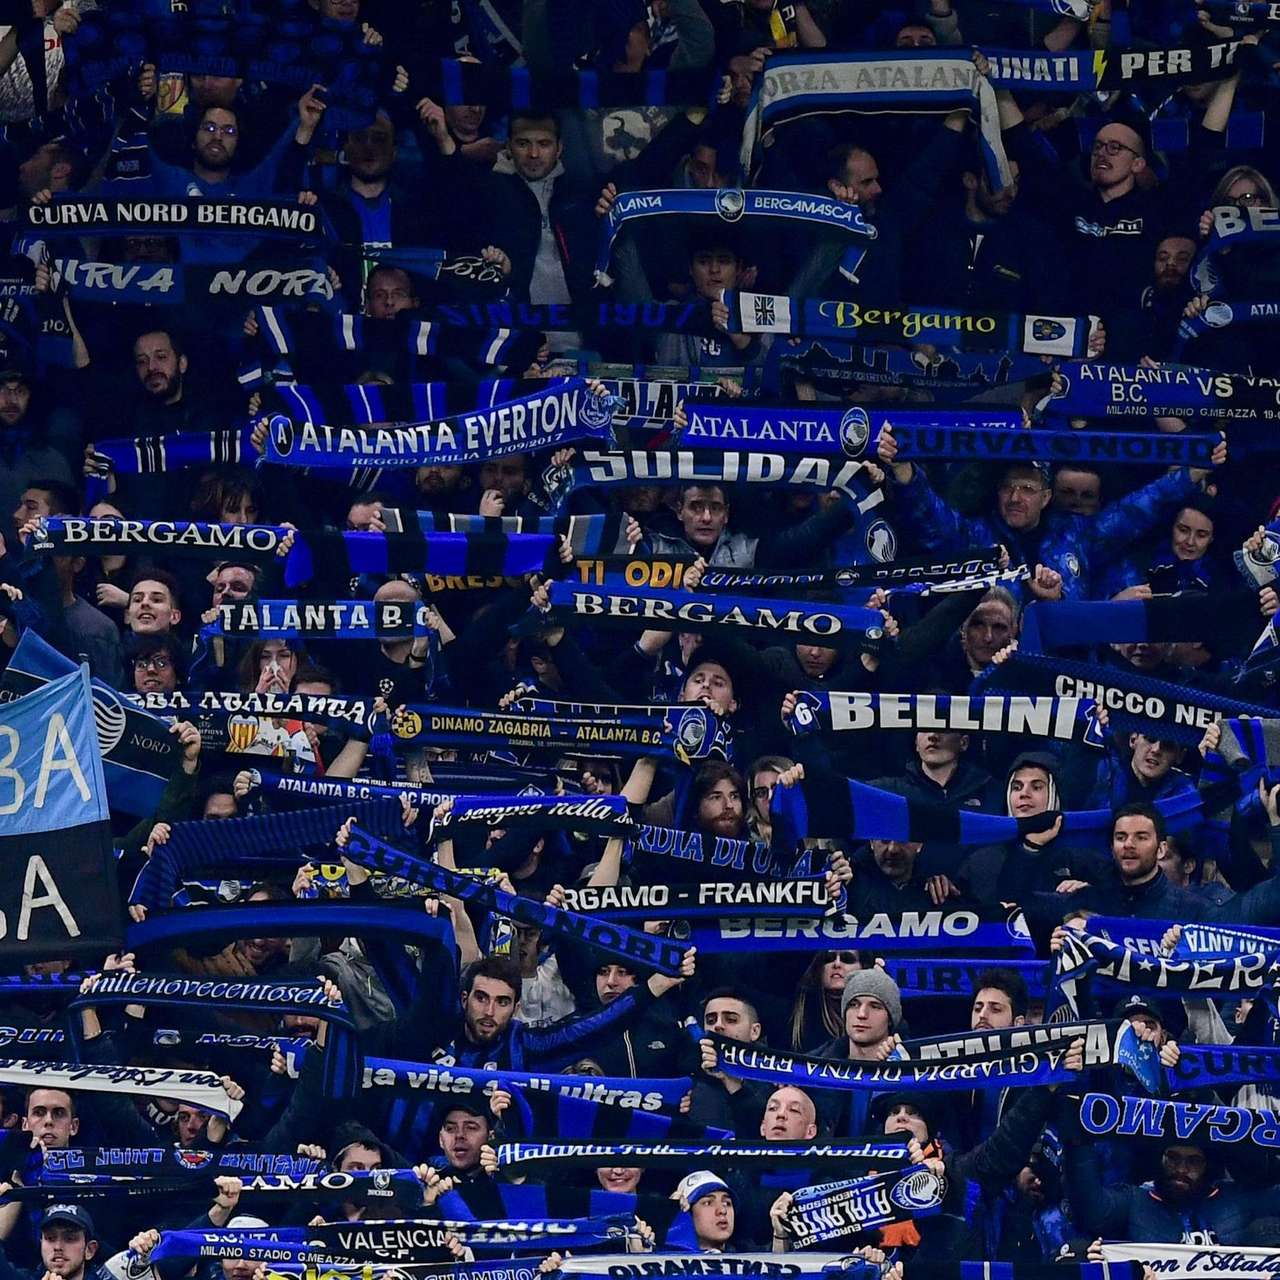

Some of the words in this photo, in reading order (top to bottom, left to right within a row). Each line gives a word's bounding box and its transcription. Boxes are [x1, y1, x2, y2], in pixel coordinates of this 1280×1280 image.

[1121, 48, 1198, 80] PER
[29, 202, 109, 226] CURVA
[116, 202, 187, 224] NORD
[197, 204, 316, 234] BERGAMO
[819, 300, 997, 336] Bergamo
[299, 419, 457, 454] ATALANTA
[463, 390, 578, 451] EVERTON
[688, 409, 835, 442] ATALANTA
[1153, 407, 1195, 418] STADIO
[62, 518, 277, 551] BERGAMO
[574, 593, 843, 637] BERGAMO
[1053, 673, 1166, 719] CHICCO
[431, 715, 482, 733] DINAMO
[487, 717, 552, 738] ZAGABRIA
[576, 724, 634, 743] ATALANTA
[829, 691, 1079, 742] BELLINI
[277, 777, 341, 797] ATALANTA
[345, 784, 373, 800] B.C.
[721, 910, 980, 941] BERGAMO
[200, 1245, 242, 1258] MILANO
[248, 1248, 292, 1261] STADIO
[337, 1228, 447, 1251] VALENCIA
